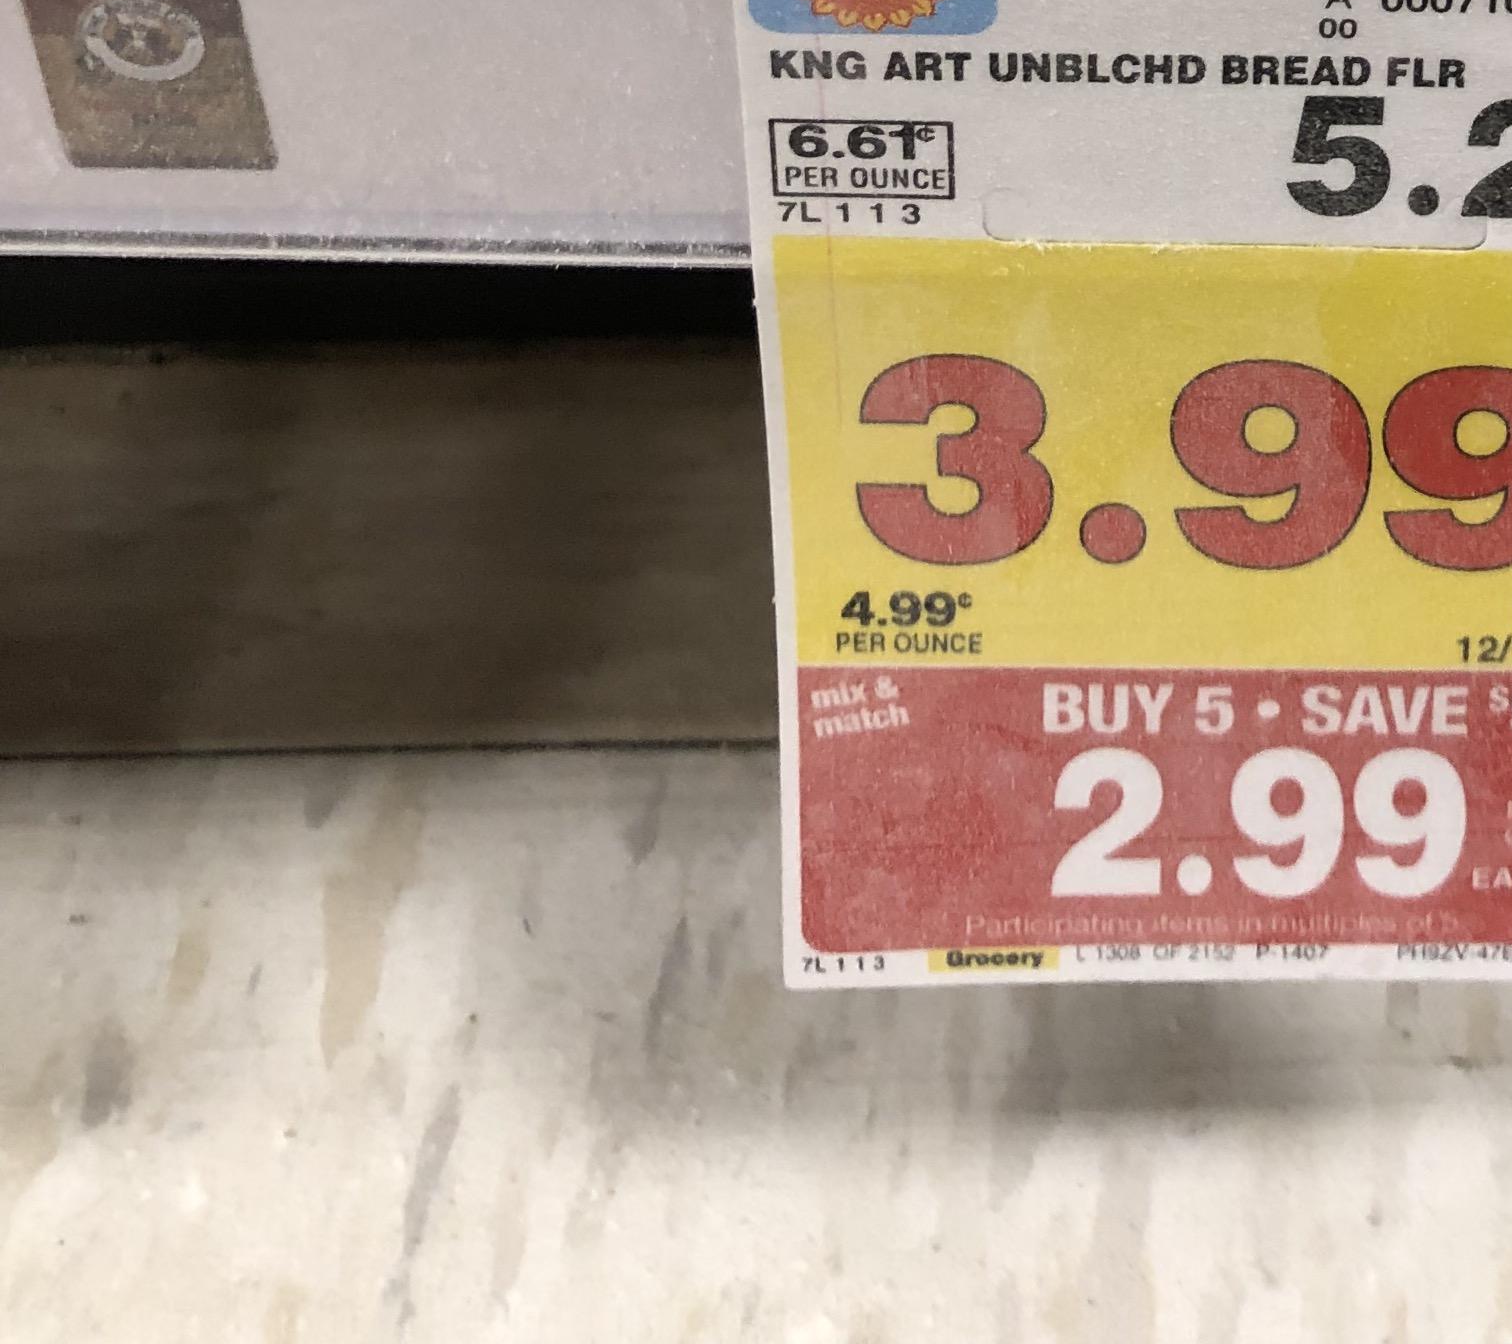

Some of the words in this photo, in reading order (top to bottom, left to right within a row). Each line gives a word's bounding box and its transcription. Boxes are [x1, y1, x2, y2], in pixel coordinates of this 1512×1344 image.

[1318, 17, 1358, 39] 00
[770, 48, 868, 81] KNG
[883, 51, 972, 83] ART
[988, 51, 1207, 86] UNBLCHD
[1221, 54, 1372, 87] BREAD
[1387, 57, 1467, 88] FLR
[784, 165, 838, 189] PER
[849, 167, 947, 191] OUNCE
[836, 632, 886, 655] PER
[894, 632, 984, 655] OUNCE
[810, 679, 866, 710] mix
[873, 675, 900, 700] &
[1042, 681, 1174, 735] BUY
[1194, 684, 1234, 736] 5
[1300, 685, 1468, 737] SAVE
[813, 703, 911, 739] match
[1050, 746, 1468, 899] 2.99
[945, 949, 1046, 970] Grocery
